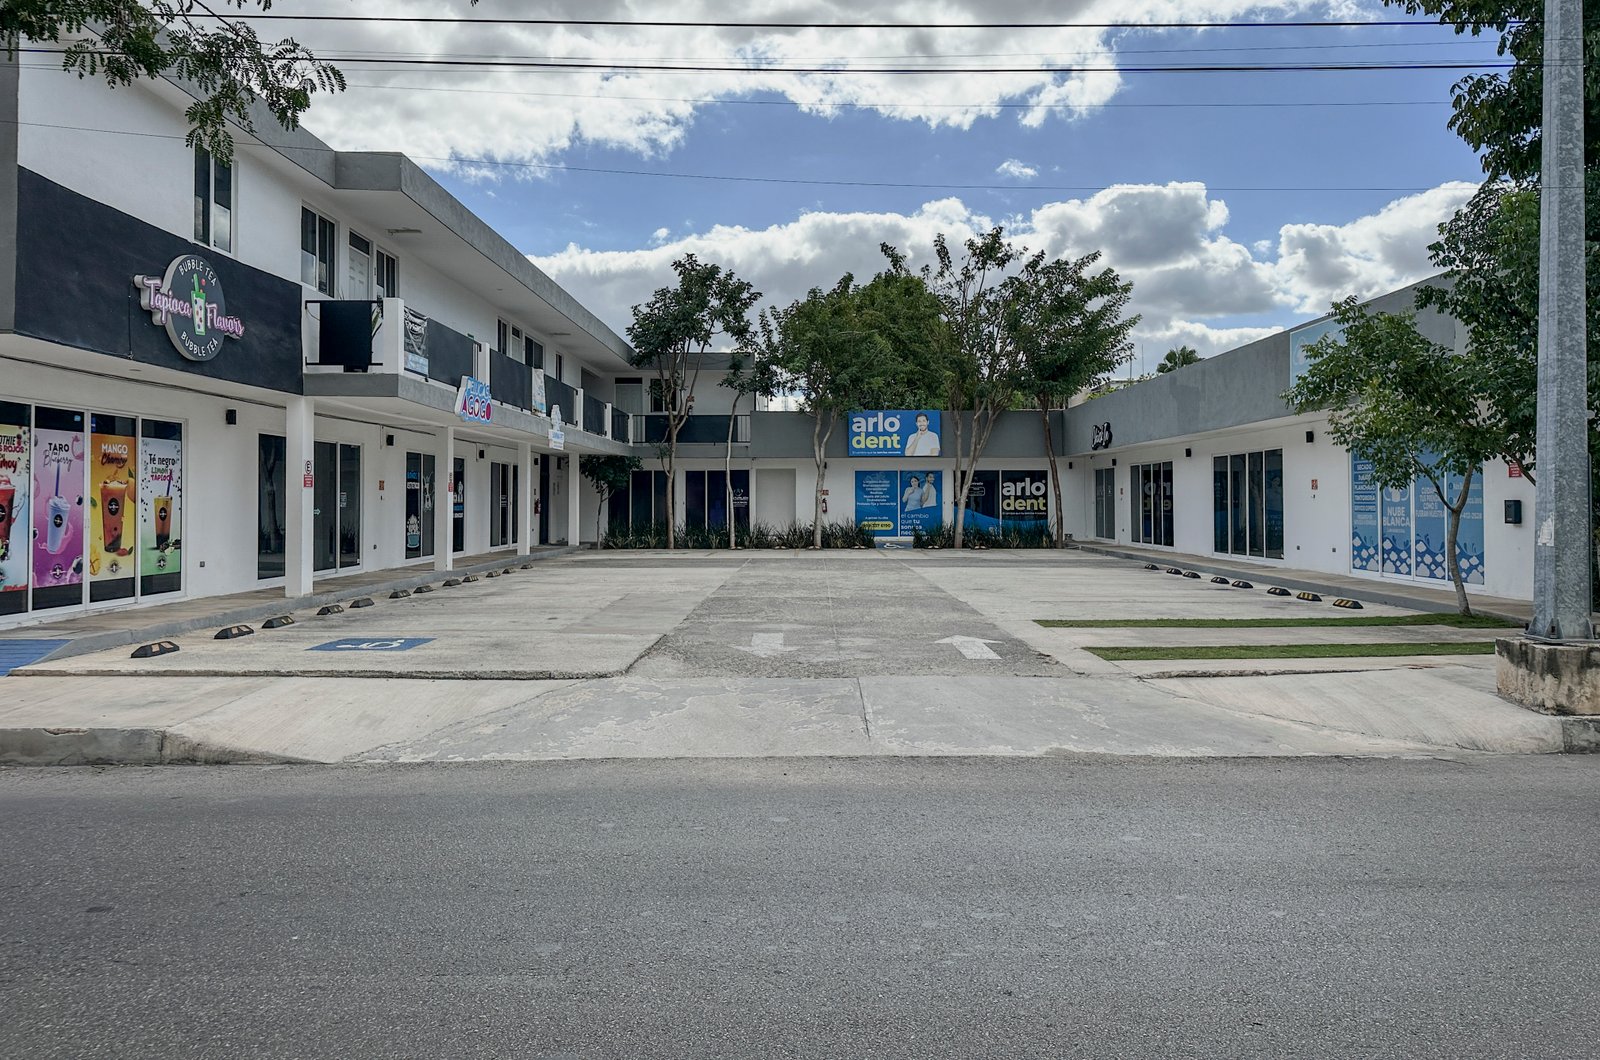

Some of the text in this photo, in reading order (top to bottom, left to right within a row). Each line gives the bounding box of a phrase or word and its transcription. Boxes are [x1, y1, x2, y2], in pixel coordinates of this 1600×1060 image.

[178, 259, 218, 287] BUBBLE TEA
[143, 277, 245, 337] Tapioca Flavors
[180, 331, 219, 357] BUBBLE TEA
[462, 394, 492, 421] AGOGO
[851, 412, 900, 433] arlo
[48, 443, 70, 453] TARO
[101, 443, 128, 454] MANGO
[851, 432, 901, 449] dent
[3, 445, 24, 453] ROJOS
[148, 453, 176, 468] Té negro
[1002, 478, 1046, 496] arlo
[1002, 496, 1046, 511] dent
[1387, 506, 1406, 517] NUBE
[1382, 516, 1411, 528] BLANCA
